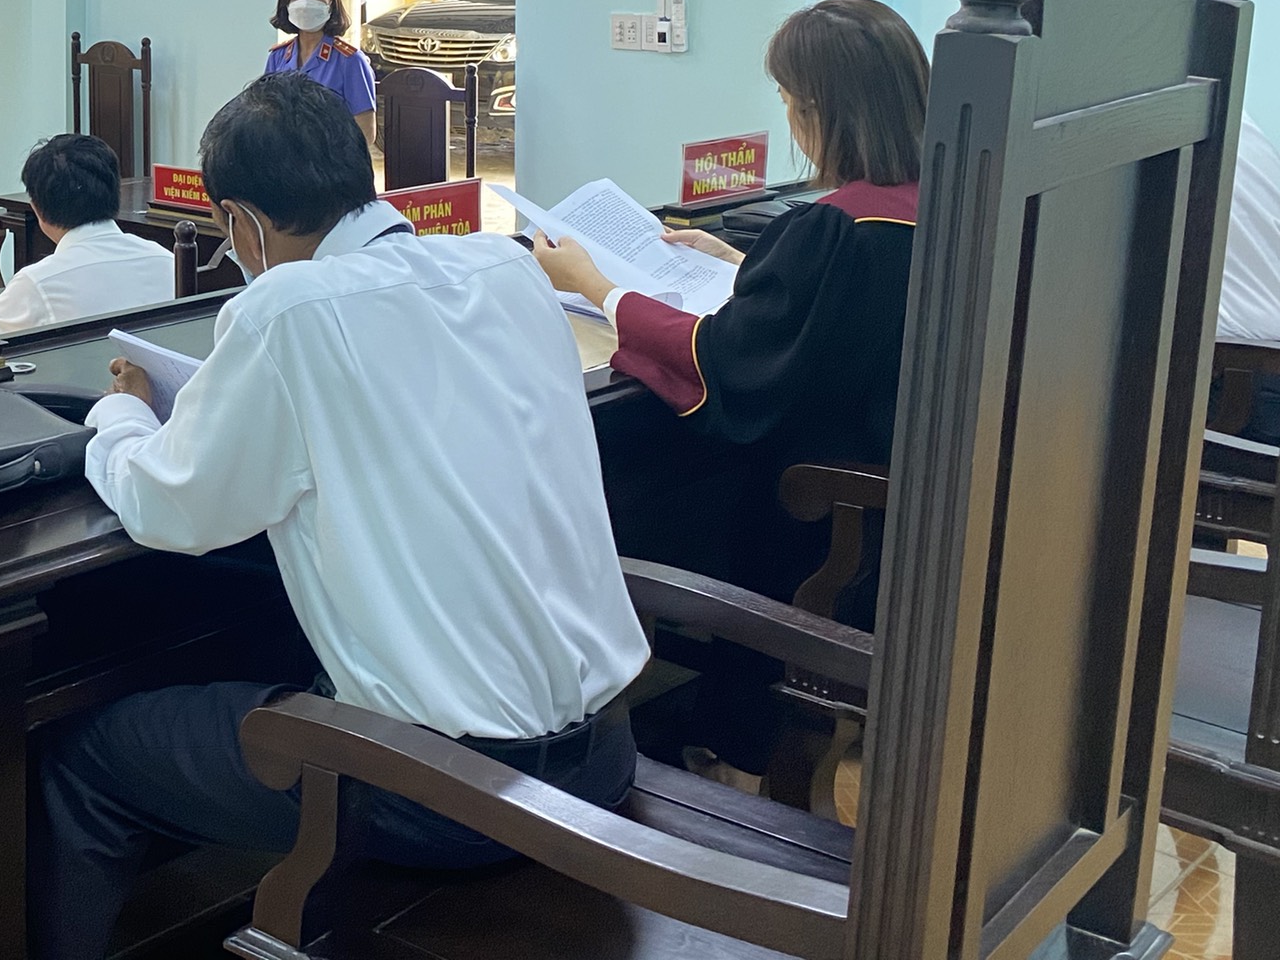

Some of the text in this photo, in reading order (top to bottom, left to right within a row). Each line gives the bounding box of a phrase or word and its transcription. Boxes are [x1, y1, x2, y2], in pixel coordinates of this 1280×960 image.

[695, 142, 756, 174] HỘI THẨM
[692, 168, 756, 196] NHÂN DÂN
[423, 199, 452, 220] PHÁN
